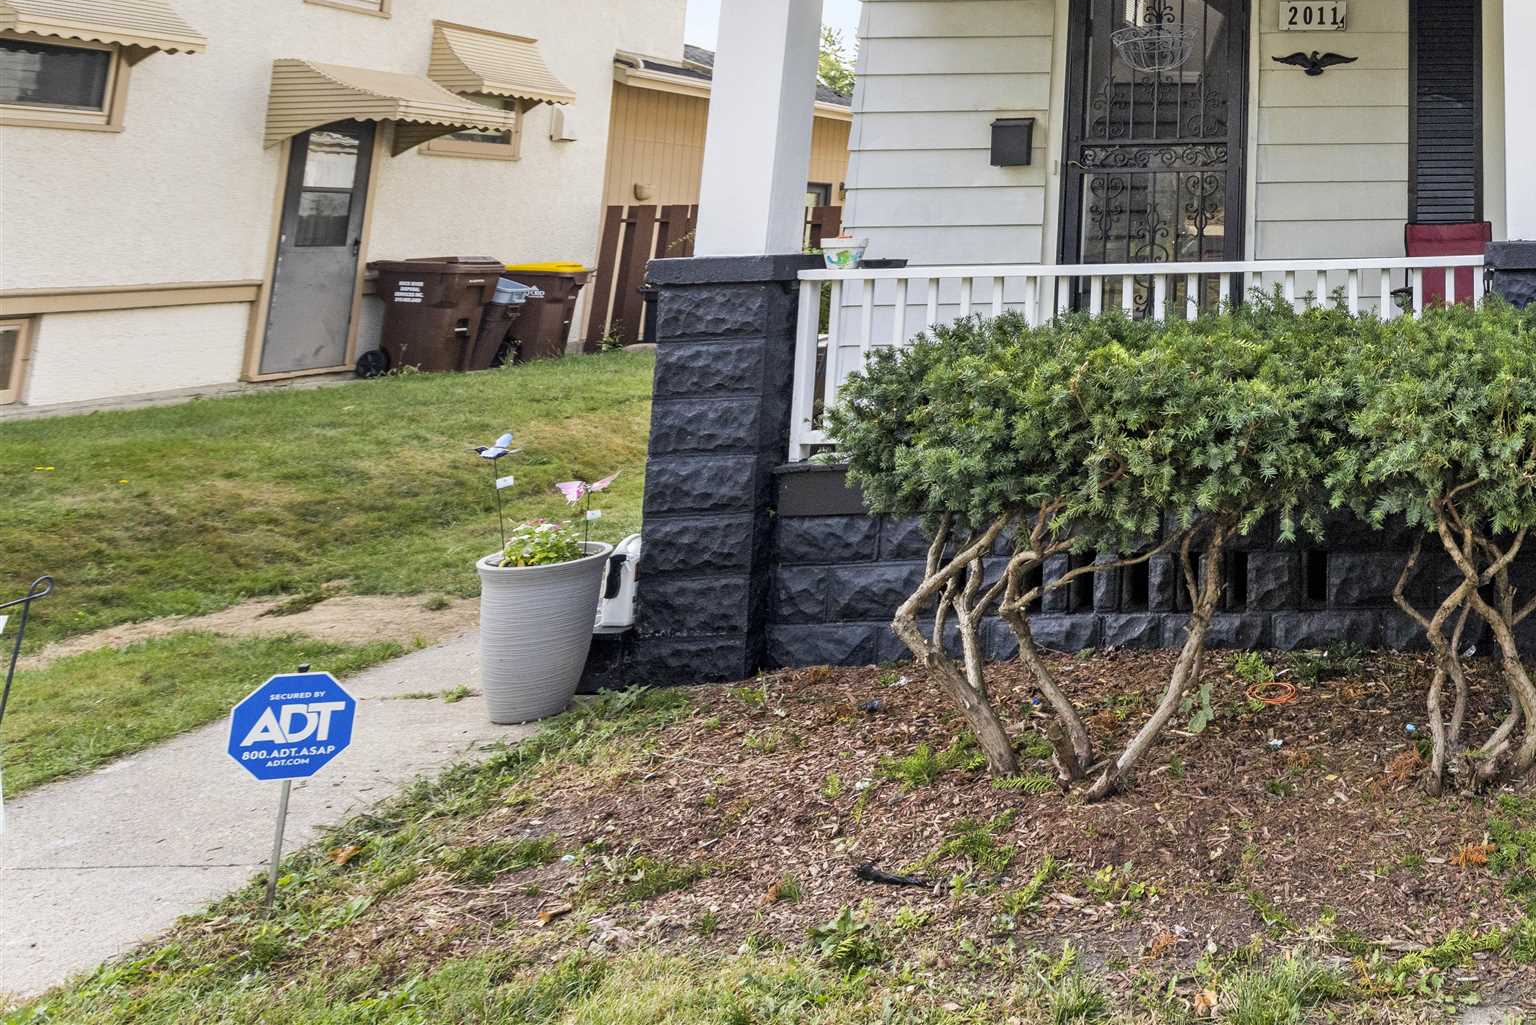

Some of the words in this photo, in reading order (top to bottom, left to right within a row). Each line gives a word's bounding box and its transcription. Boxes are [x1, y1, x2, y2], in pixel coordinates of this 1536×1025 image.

[1288, 6, 1339, 25] 2011
[269, 692, 312, 701] SECURED
[240, 701, 346, 747] ADT
[241, 745, 336, 761] 800.ADT.ASAP
[265, 758, 310, 767] ADT.COM
